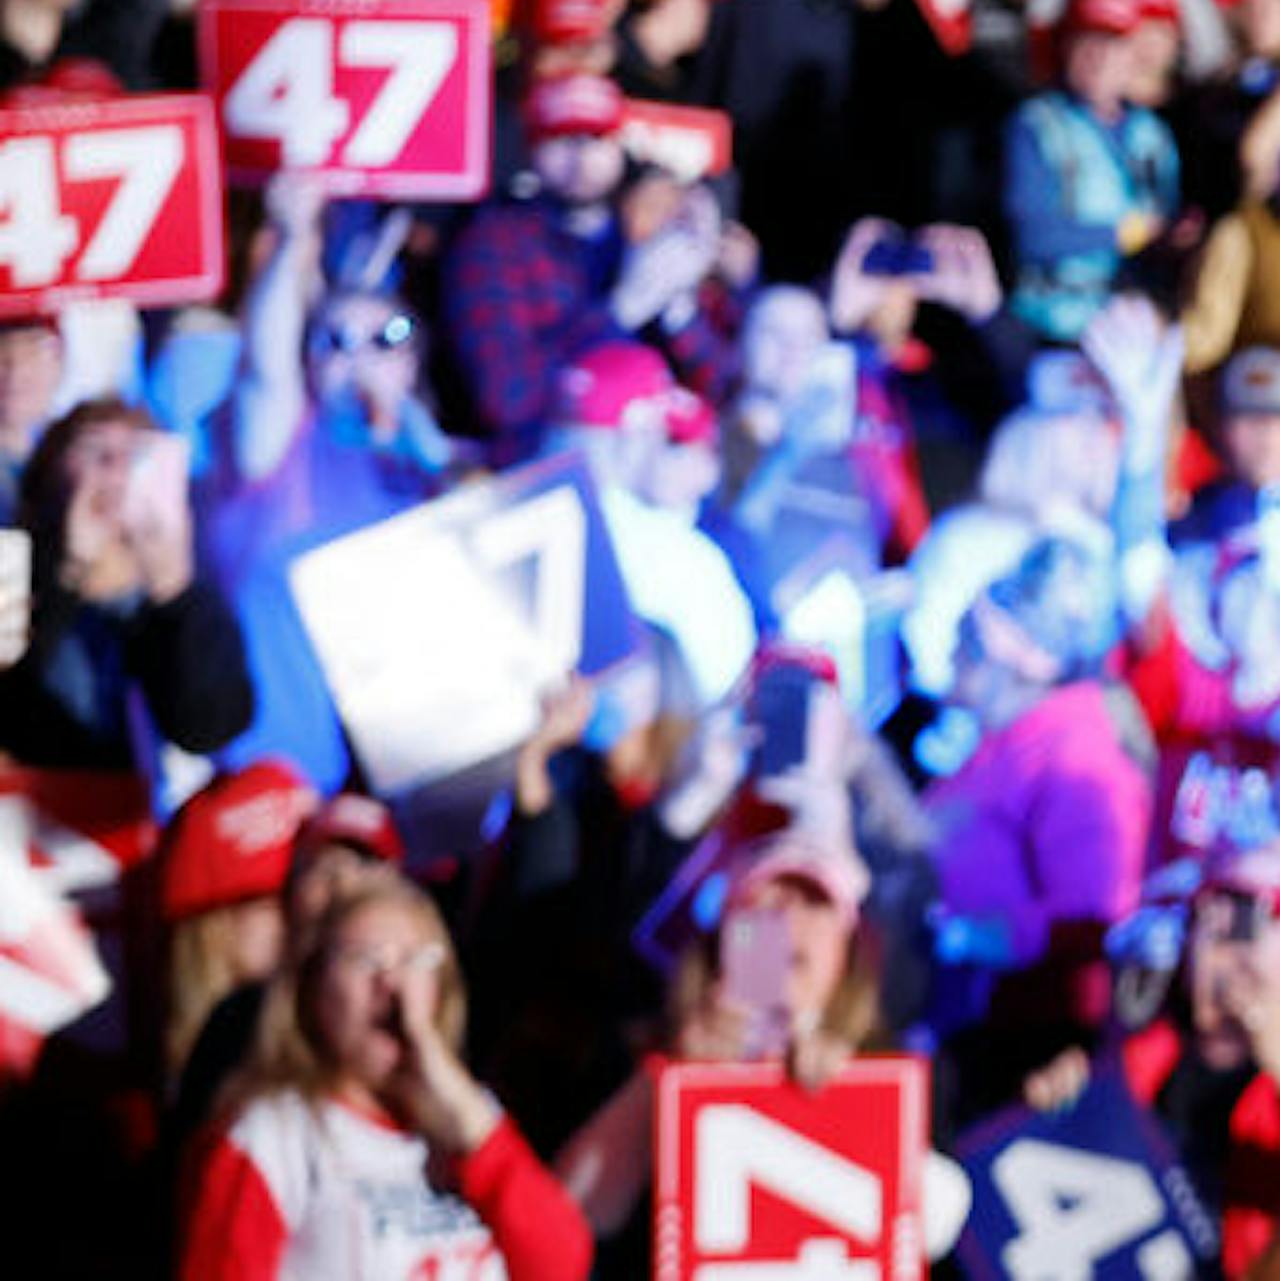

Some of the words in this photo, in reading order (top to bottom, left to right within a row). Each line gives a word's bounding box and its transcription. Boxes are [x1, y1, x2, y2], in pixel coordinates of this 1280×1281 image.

[224, 17, 459, 169] 47
[0, 124, 186, 289] 47
[692, 1102, 884, 1281] 7
[989, 1133, 1194, 1281] 4
